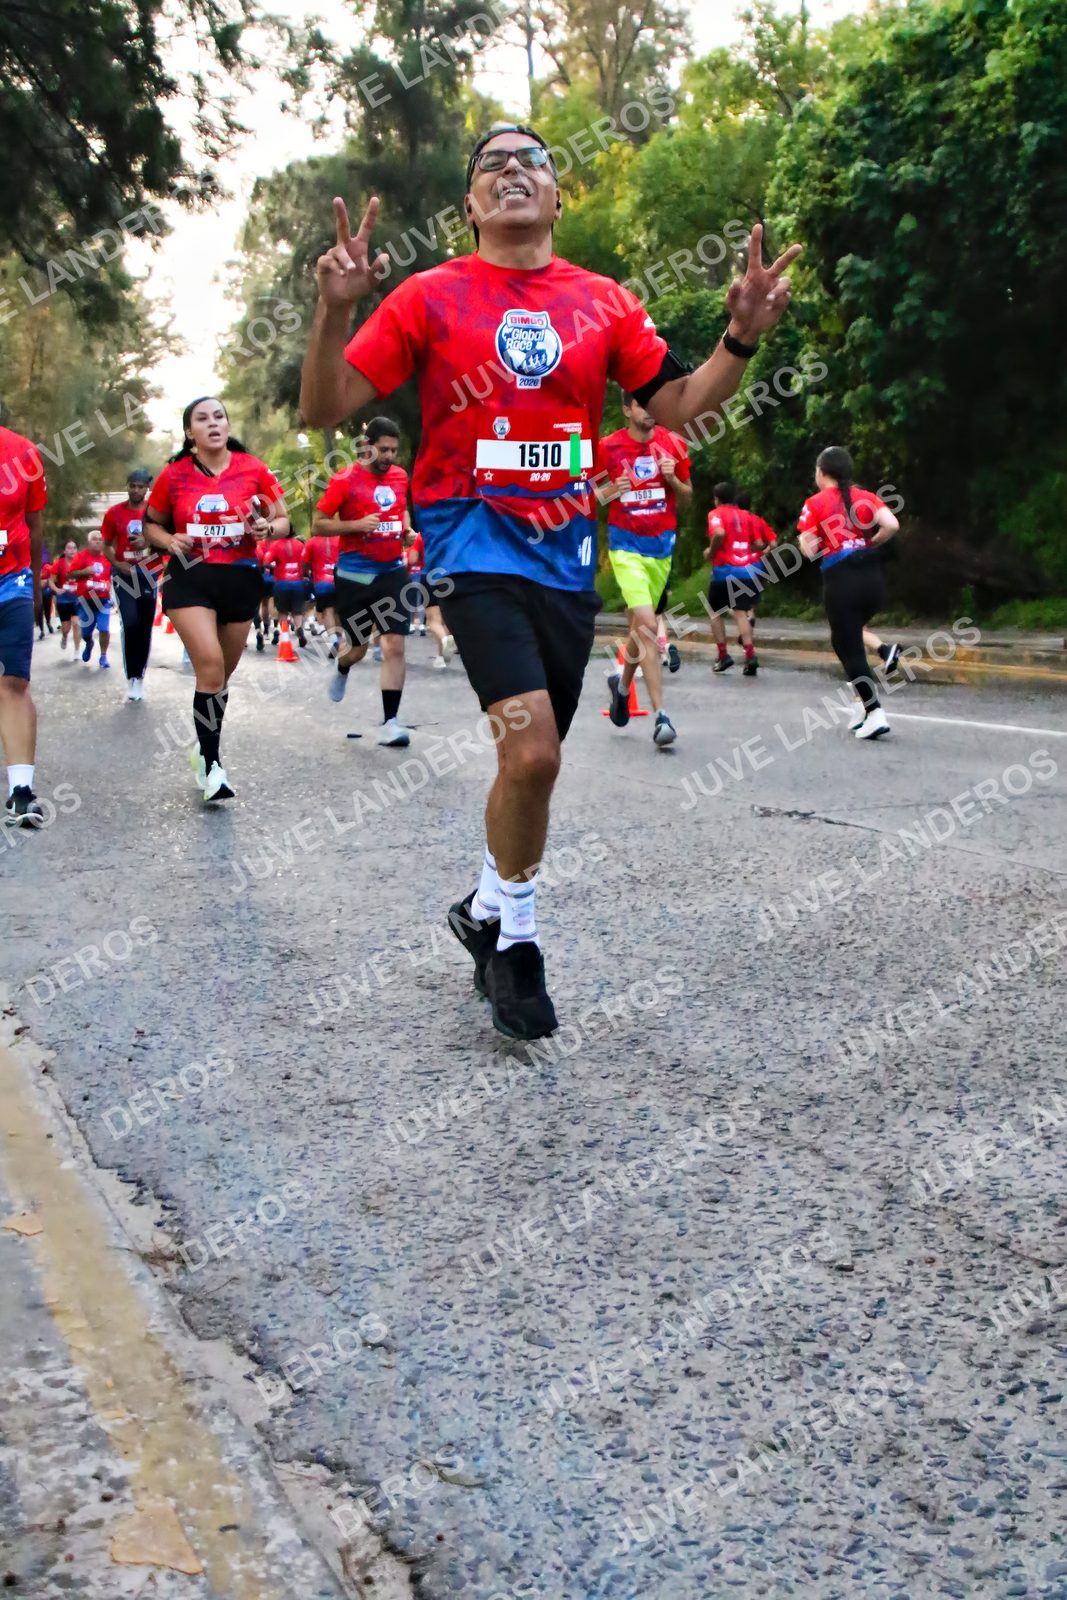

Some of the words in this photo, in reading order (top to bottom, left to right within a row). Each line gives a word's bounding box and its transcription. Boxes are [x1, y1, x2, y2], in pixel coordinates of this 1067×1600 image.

[511, 328, 545, 342] Global
[506, 337, 533, 351] Race
[518, 443, 562, 468] 1510
[203, 525, 226, 536] 2477
